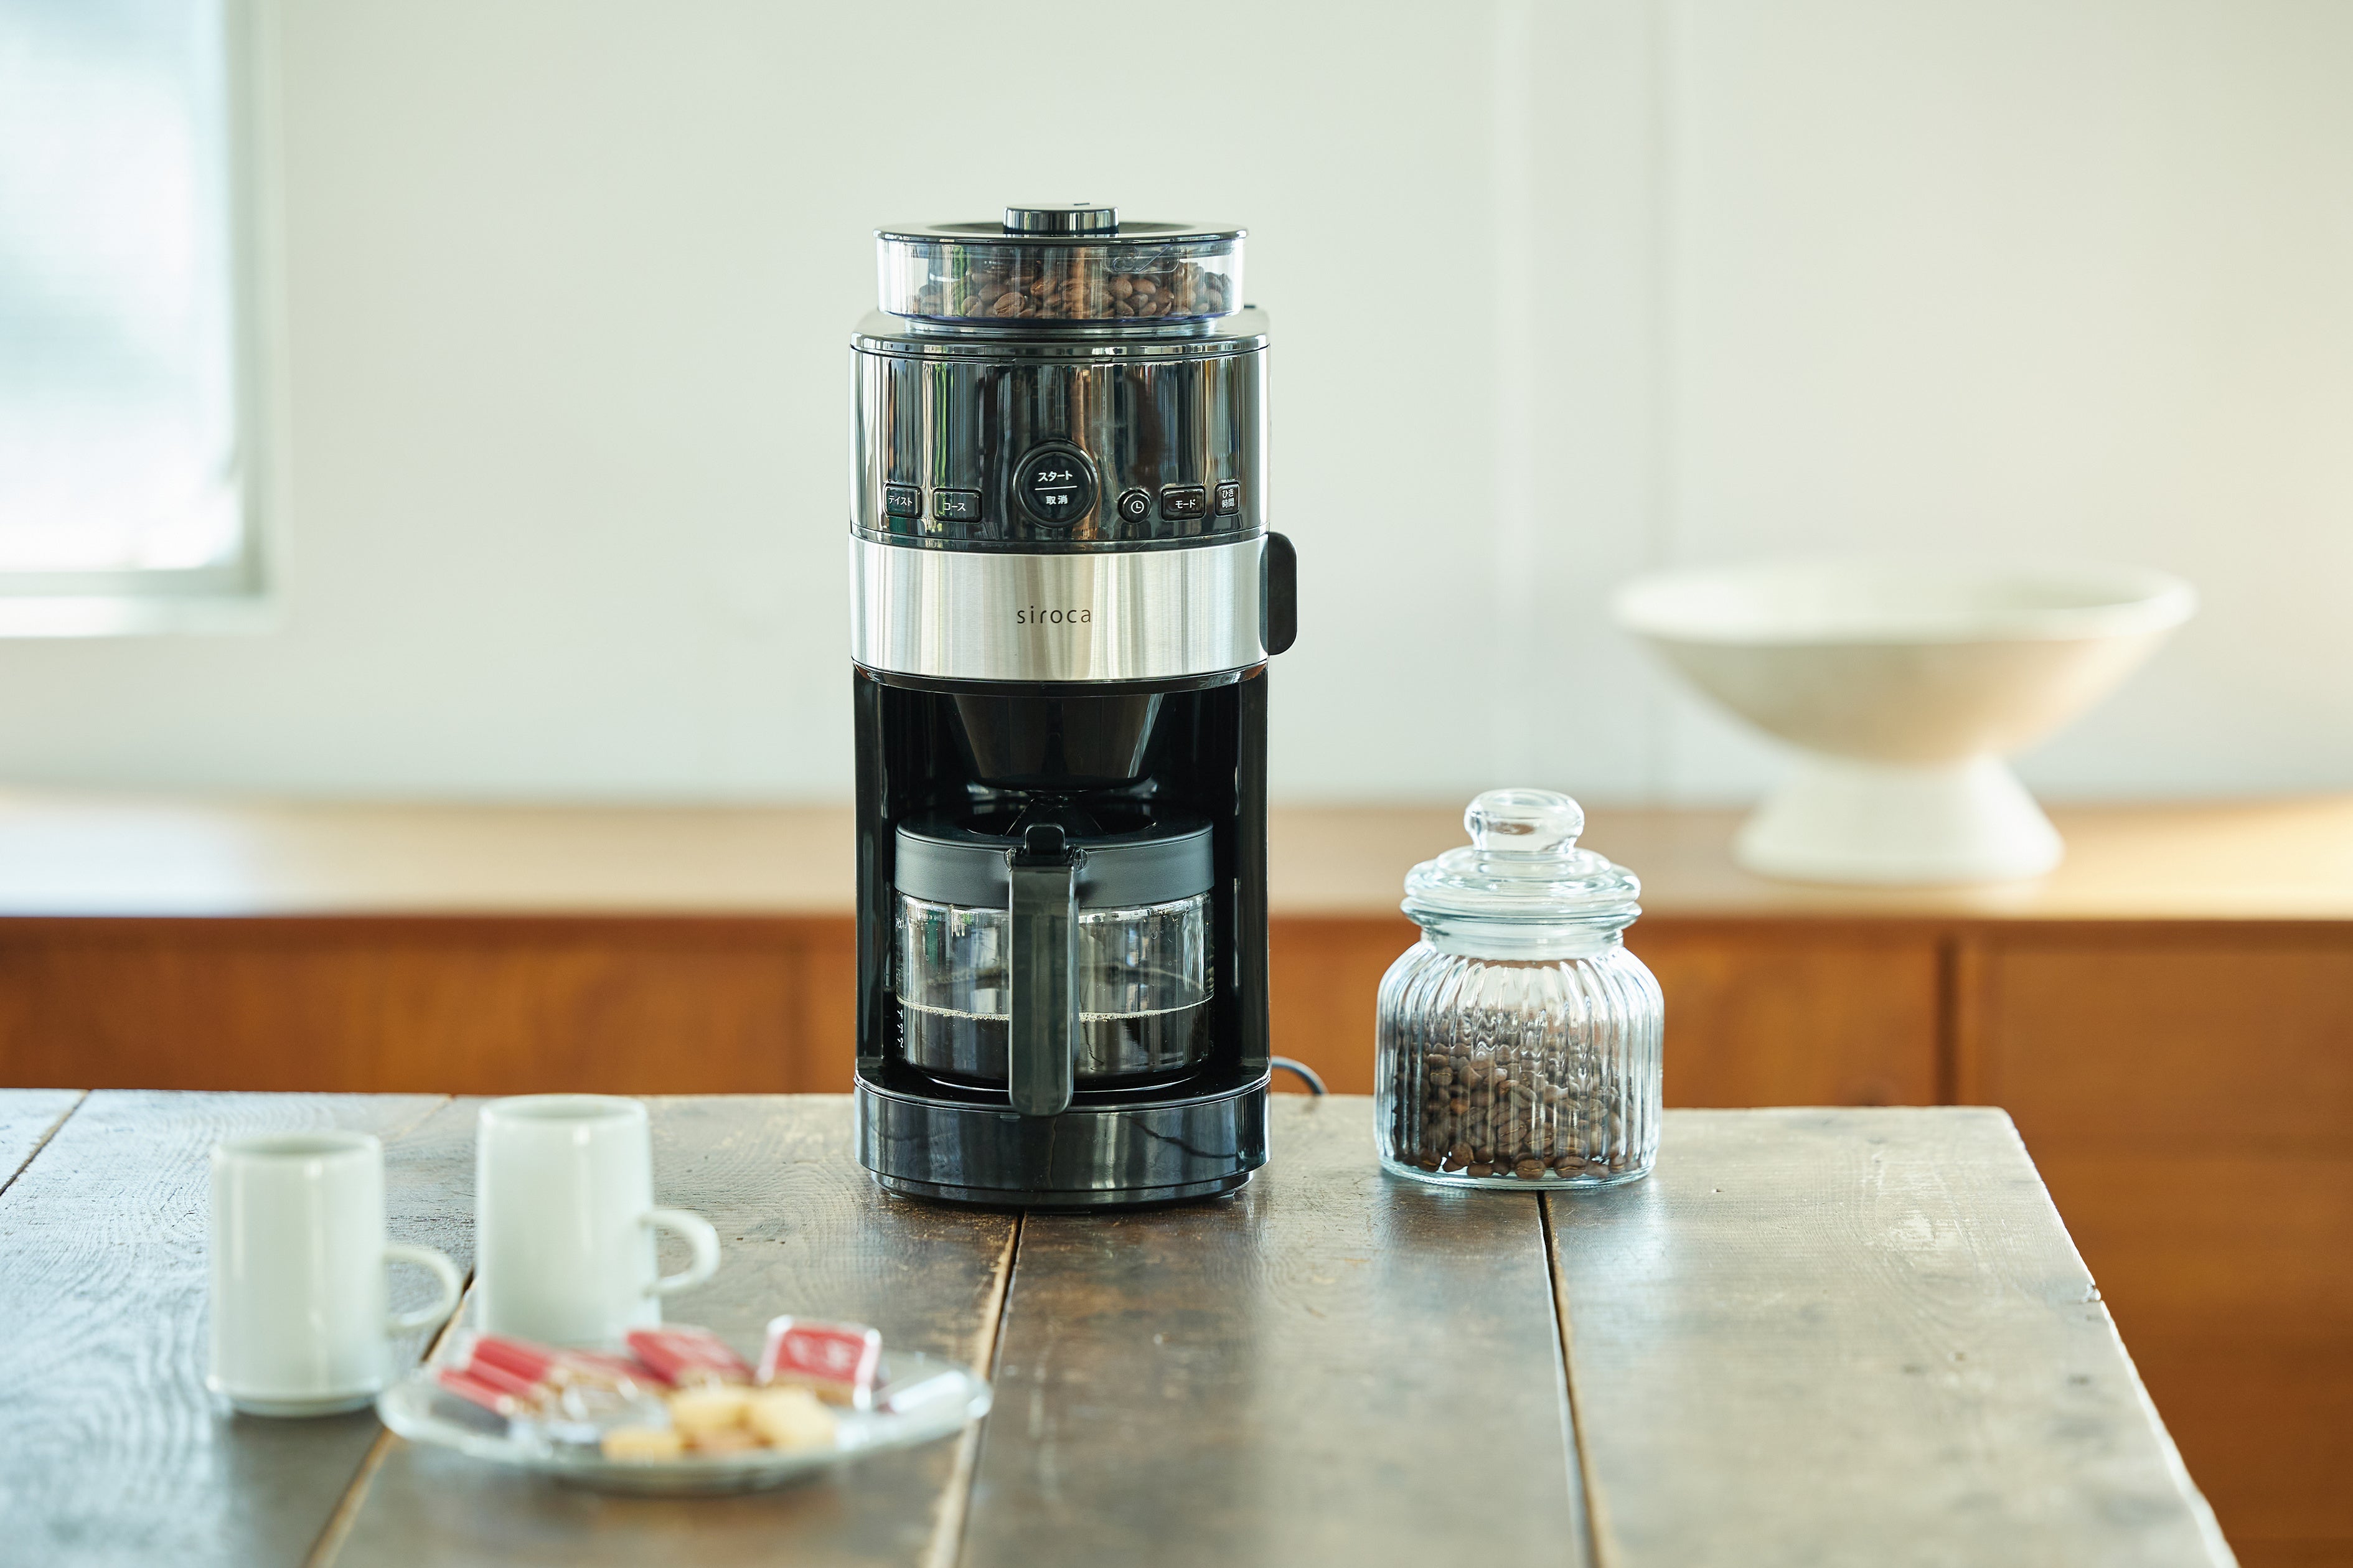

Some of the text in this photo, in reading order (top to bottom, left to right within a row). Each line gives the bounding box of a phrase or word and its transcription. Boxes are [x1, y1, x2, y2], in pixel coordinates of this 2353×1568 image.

[1038, 470, 1073, 482] スタート
[1222, 488, 1234, 499] ひき
[888, 495, 913, 507] テイスト
[1046, 495, 1068, 505] 取消
[1175, 499, 1196, 509] モード
[1222, 498, 1234, 509] 時間
[944, 502, 966, 511] コース
[1017, 606, 1091, 624] siroca
